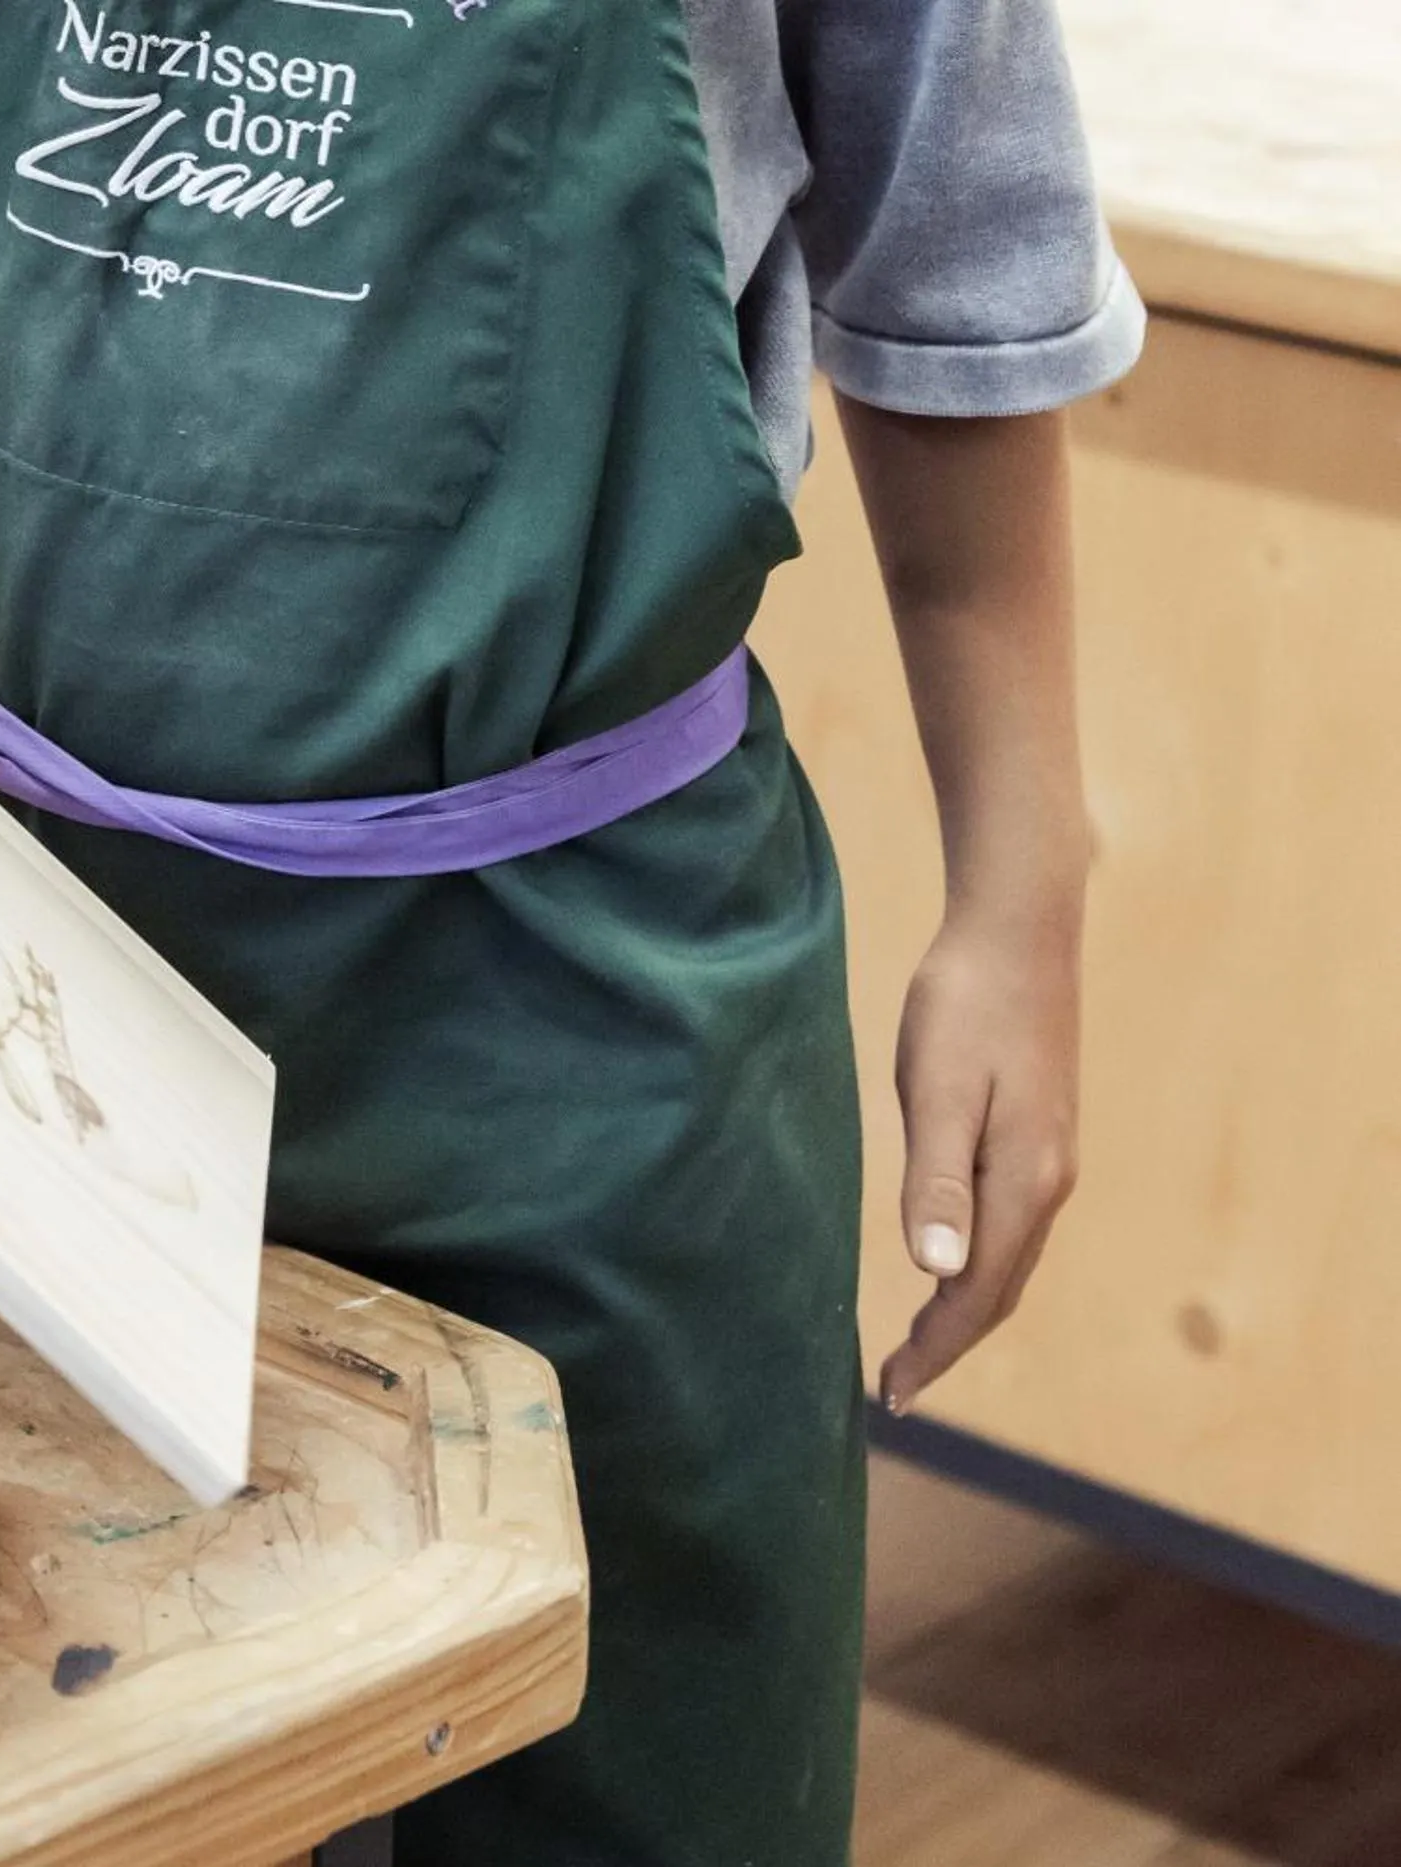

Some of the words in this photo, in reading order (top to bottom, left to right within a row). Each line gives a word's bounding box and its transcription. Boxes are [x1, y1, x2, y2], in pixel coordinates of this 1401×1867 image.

[56, 0, 356, 105] Narzissen
[15, 76, 344, 227] Zloam
[205, 95, 351, 166] dorf
